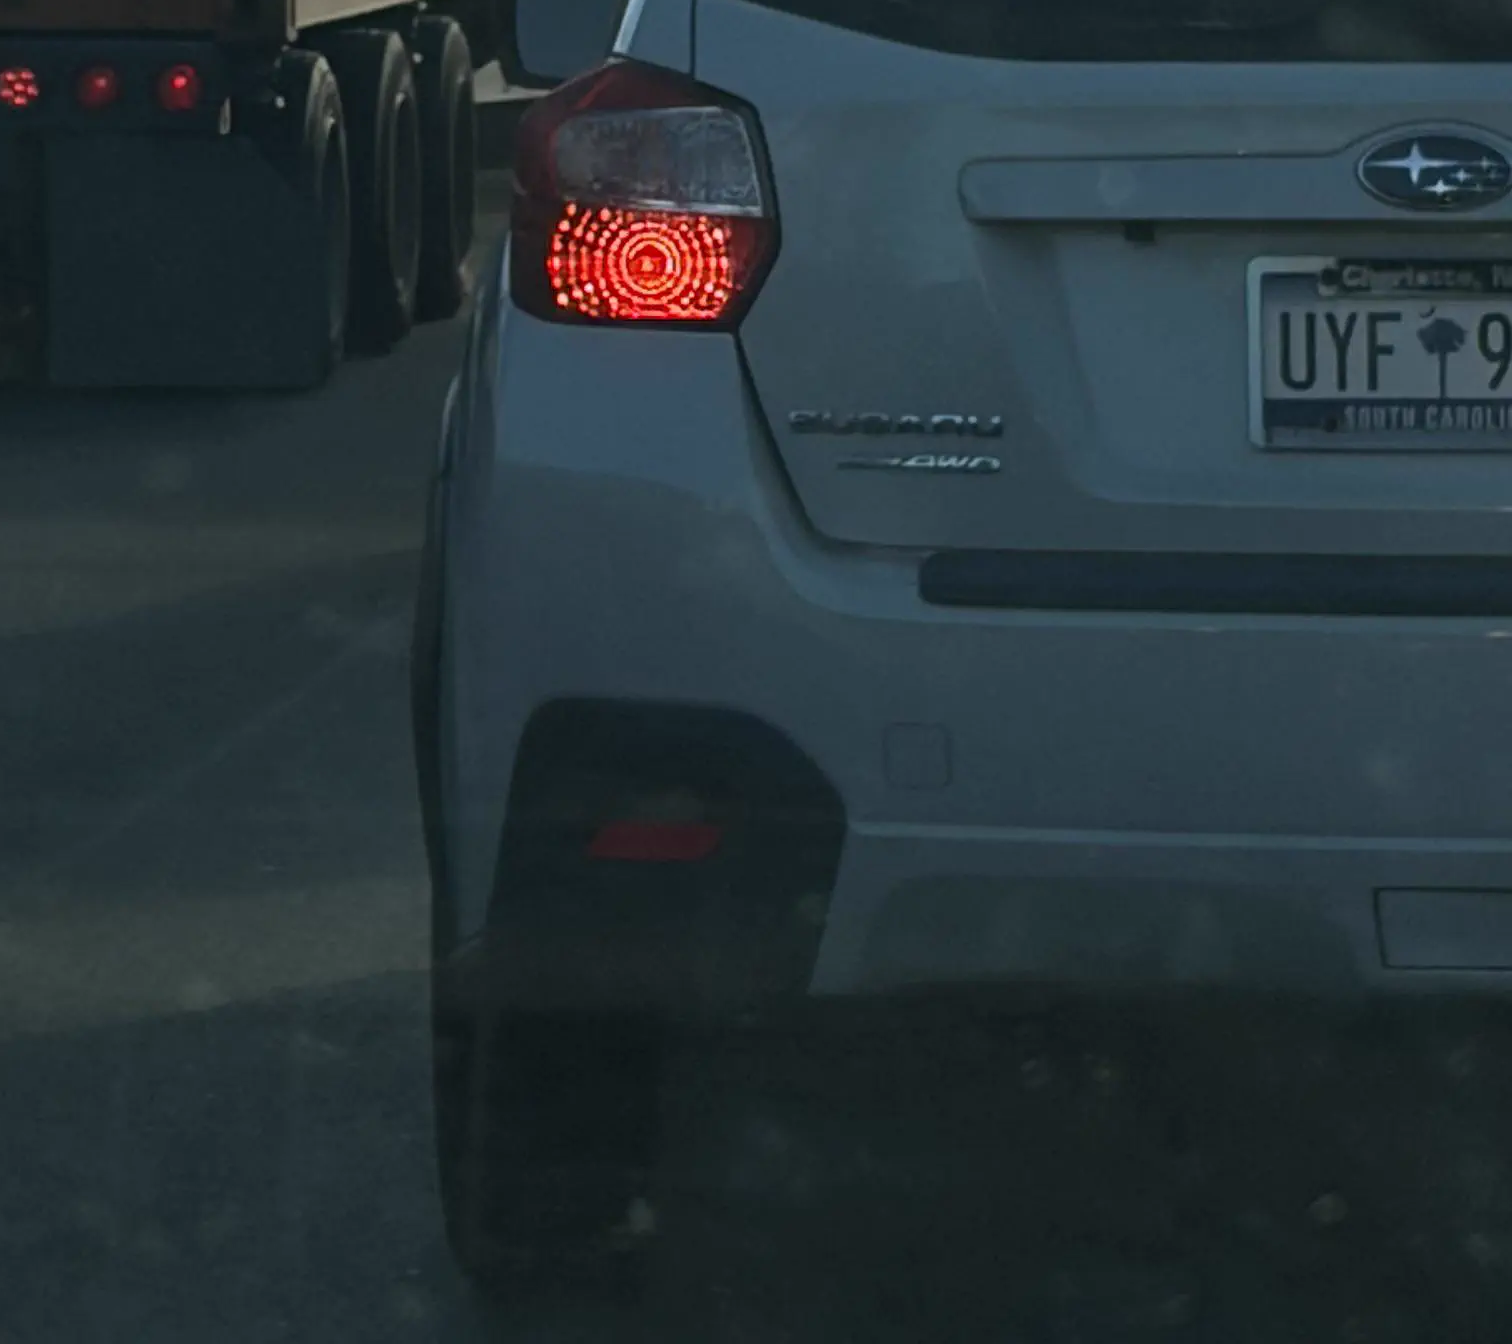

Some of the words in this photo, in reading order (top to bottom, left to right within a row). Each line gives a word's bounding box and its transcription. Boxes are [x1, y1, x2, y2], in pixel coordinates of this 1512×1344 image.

[1278, 310, 1402, 392] UYF
[1477, 311, 1512, 391] 9
[787, 408, 1005, 436] SUBARU
